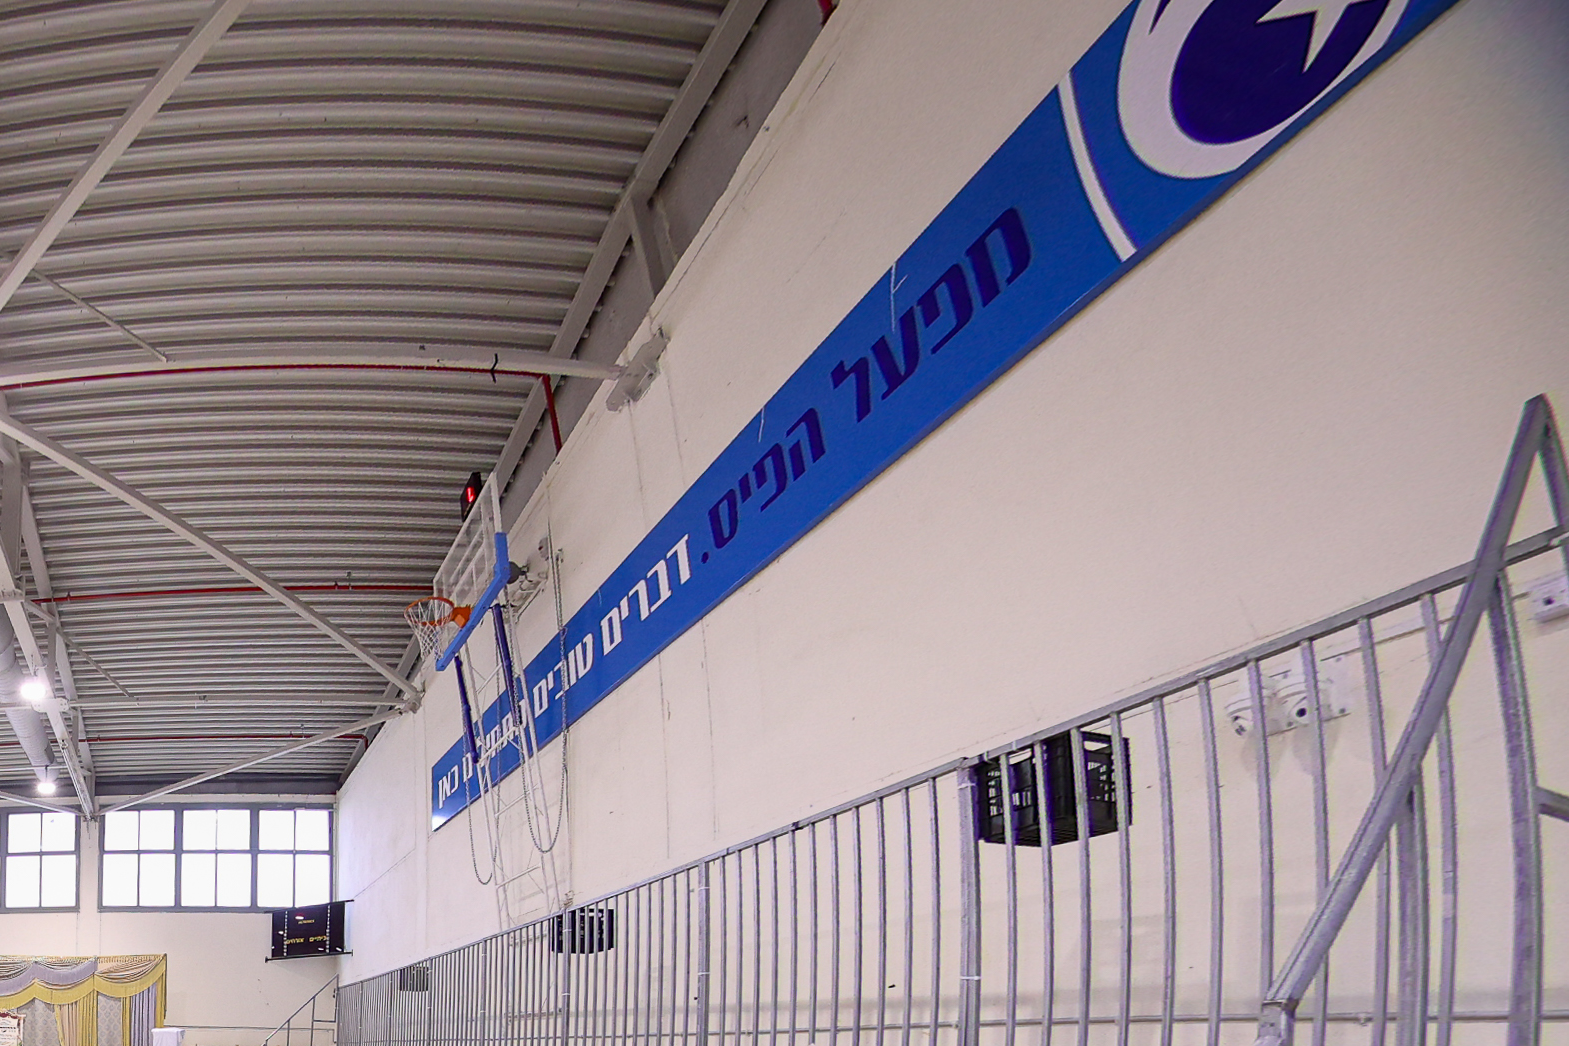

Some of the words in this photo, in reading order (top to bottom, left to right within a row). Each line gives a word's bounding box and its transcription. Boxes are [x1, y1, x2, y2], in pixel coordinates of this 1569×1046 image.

[831, 206, 1031, 422] מפעל
[701, 407, 826, 564] הפיס.
[600, 533, 691, 656] דברים
[533, 632, 594, 718] טובים
[438, 764, 459, 809] כאן
[462, 698, 528, 783] מתחילם
